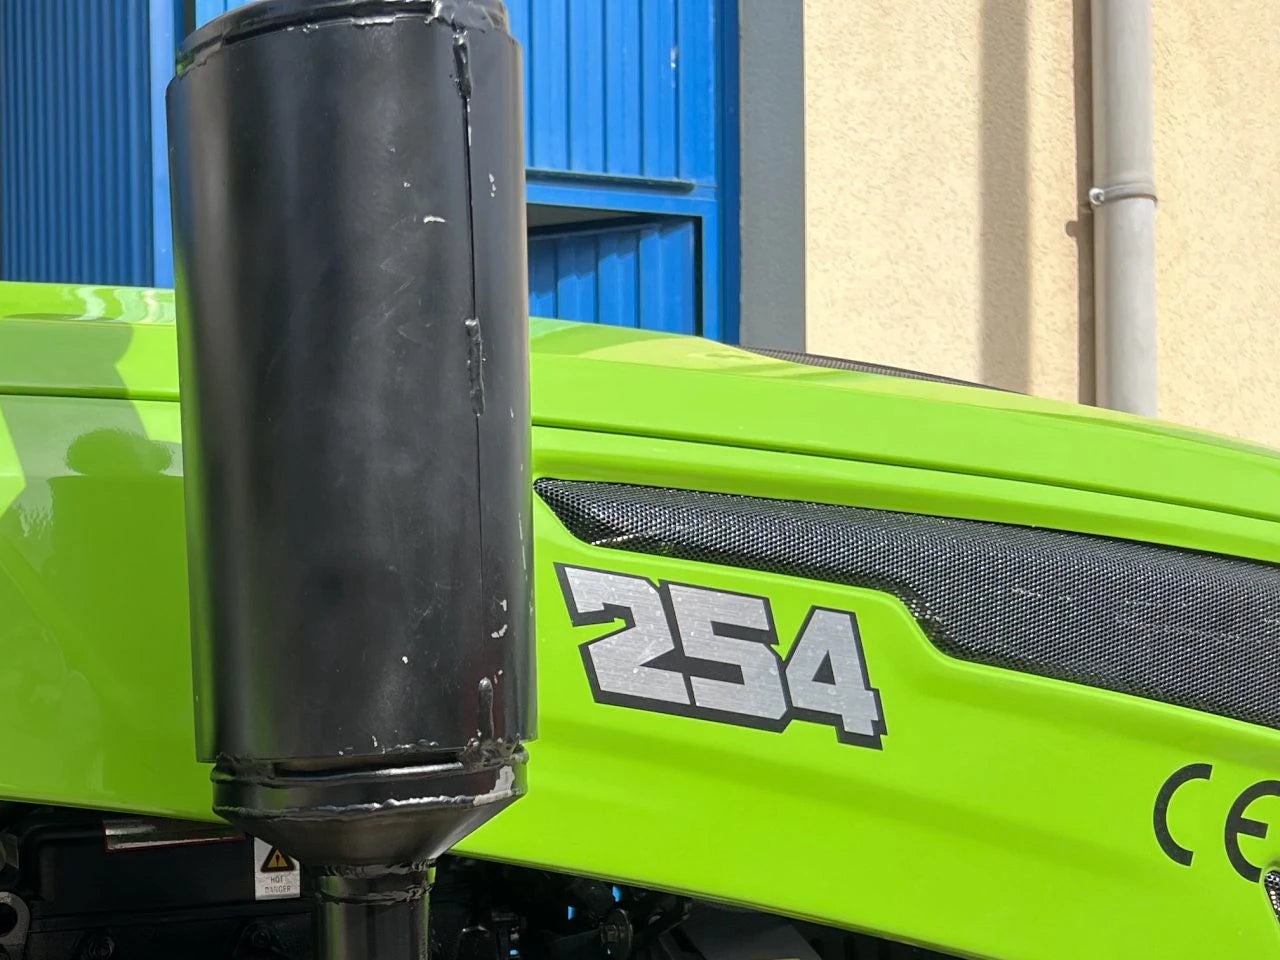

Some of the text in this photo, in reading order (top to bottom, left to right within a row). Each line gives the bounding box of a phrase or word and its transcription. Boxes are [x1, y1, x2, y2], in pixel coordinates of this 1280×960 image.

[553, 562, 887, 750] 254
[1153, 762, 1280, 883] CE
[264, 885, 291, 893] DANGER
[270, 875, 284, 884] HOT
